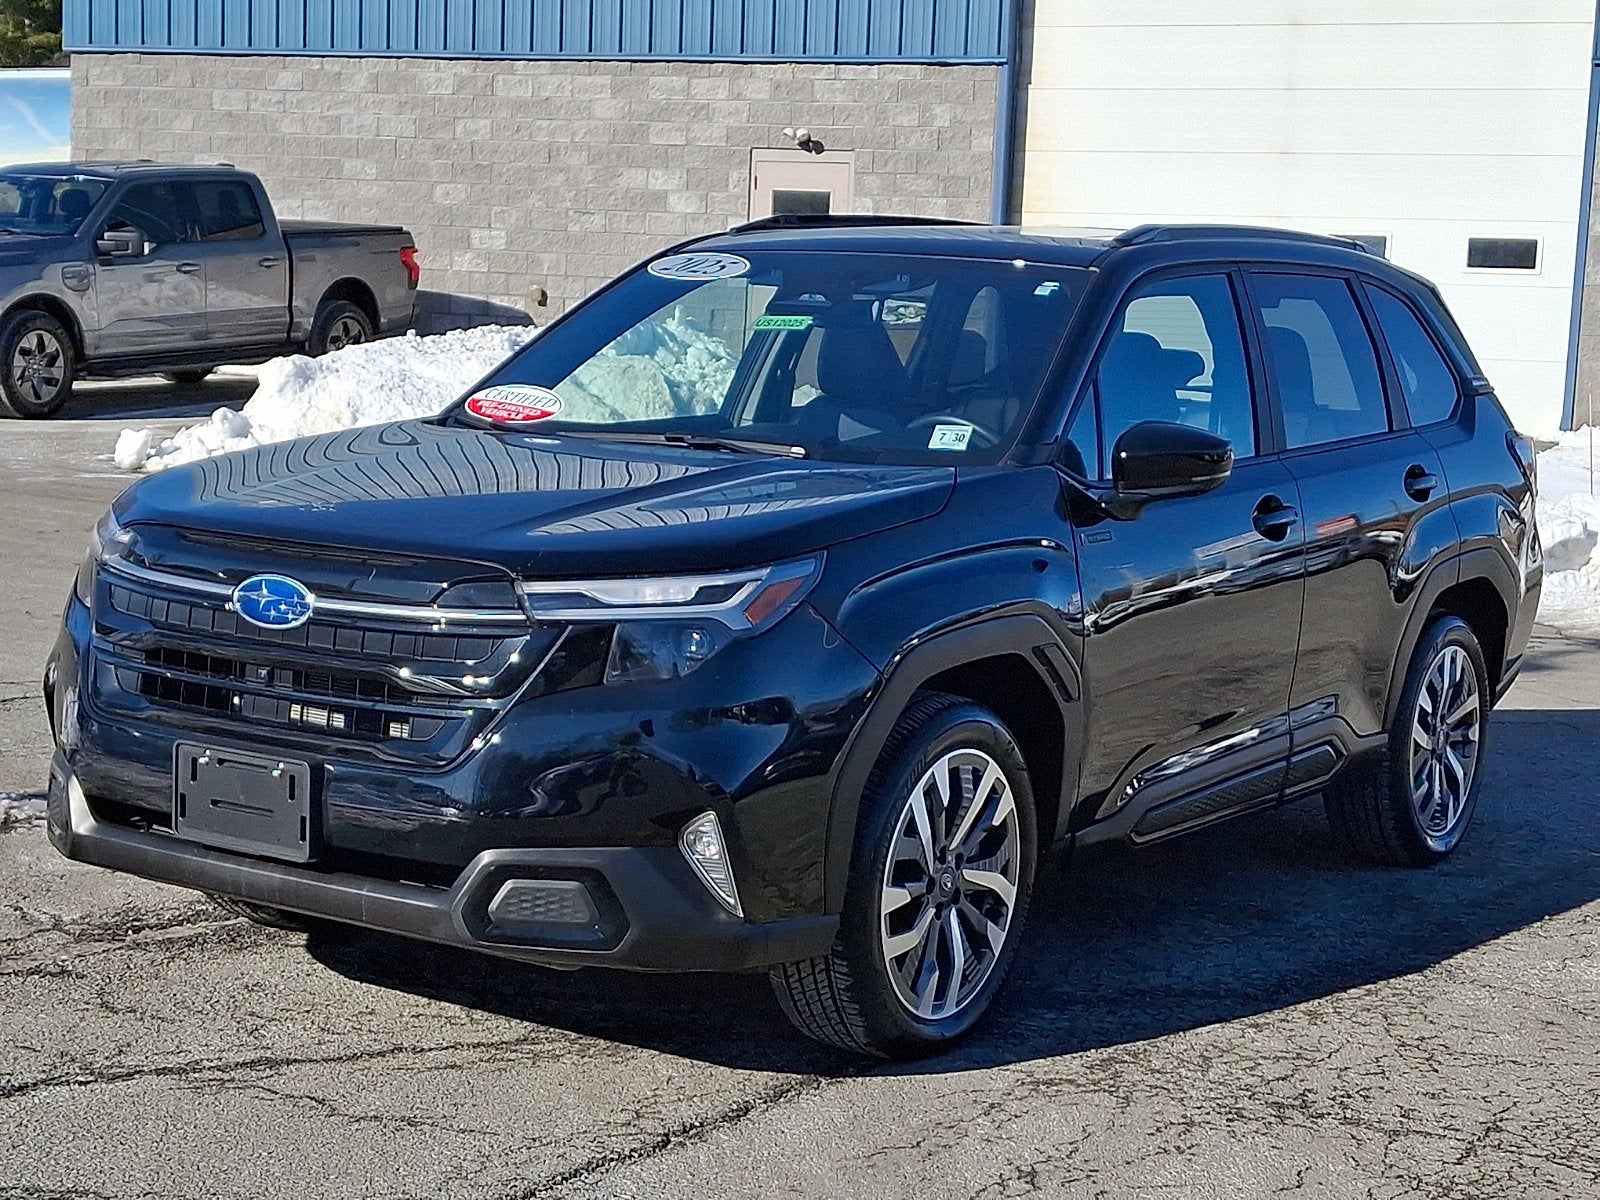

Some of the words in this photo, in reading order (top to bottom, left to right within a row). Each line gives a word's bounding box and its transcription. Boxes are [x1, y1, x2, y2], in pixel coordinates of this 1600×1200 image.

[658, 257, 740, 275] 2025
[485, 388, 558, 408] CERTIFIED
[939, 432, 948, 442] 7
[951, 432, 966, 443] 30
